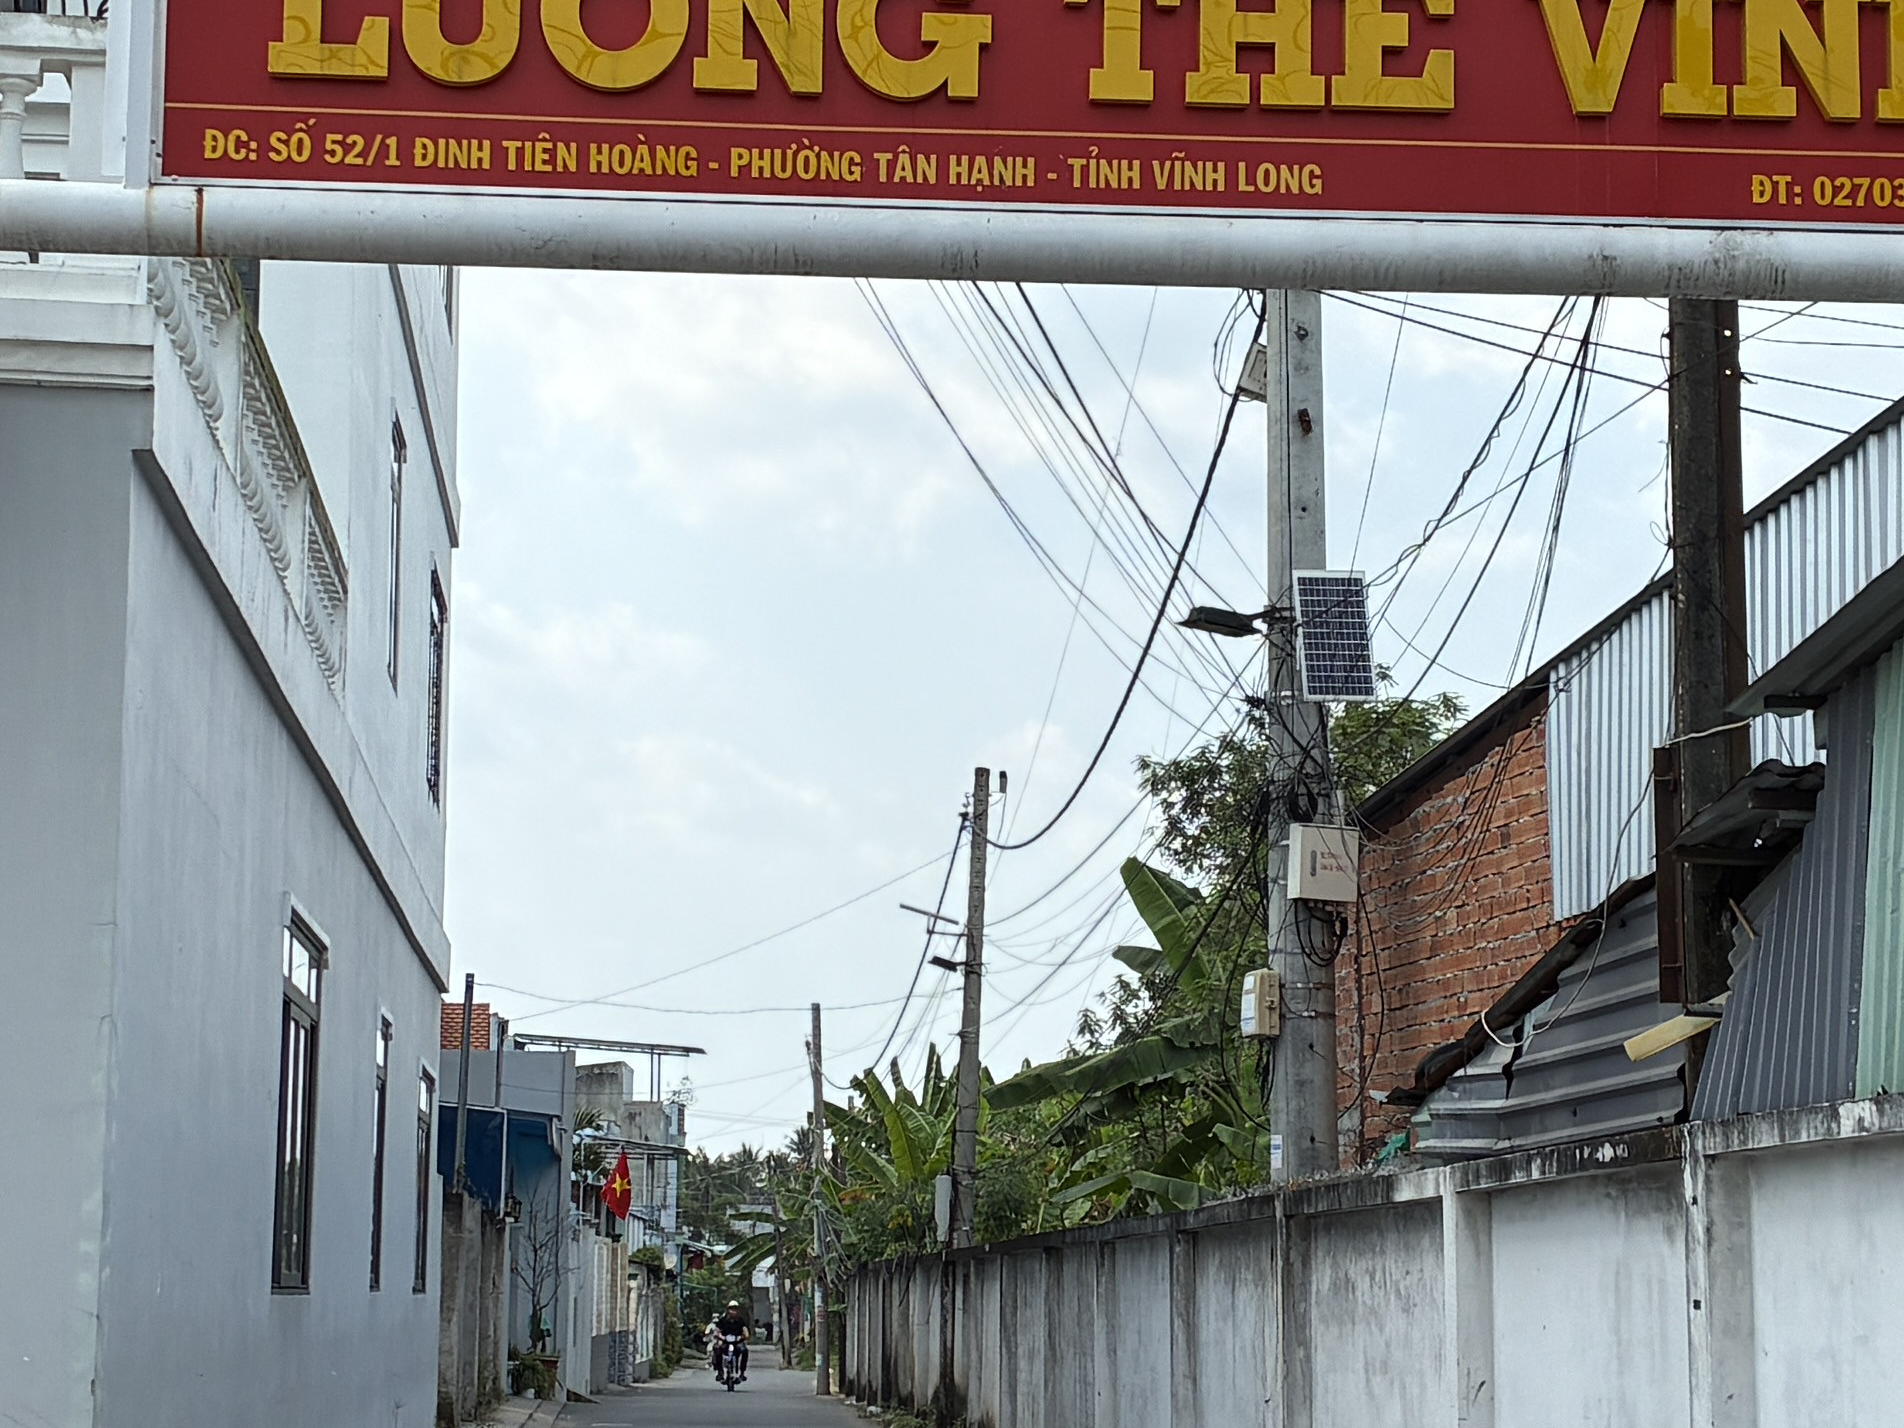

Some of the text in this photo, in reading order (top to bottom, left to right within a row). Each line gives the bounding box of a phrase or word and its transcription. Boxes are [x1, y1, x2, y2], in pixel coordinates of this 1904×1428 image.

[203, 128, 258, 161] ĐC:
[267, 119, 316, 163] SỐ
[323, 133, 400, 167] 52/1
[413, 137, 490, 169] ĐINH
[501, 132, 577, 172] TIÊN
[589, 134, 698, 177] HOÀNG
[730, 138, 862, 182] PHƯỜNG
[874, 145, 937, 184] TÂN
[949, 155, 1035, 193] HẠNH
[1068, 146, 1141, 190] TỈNH
[1152, 153, 1225, 191] VĨNH
[1238, 162, 1323, 195] LONG
[1751, 175, 1802, 204] ĐT:
